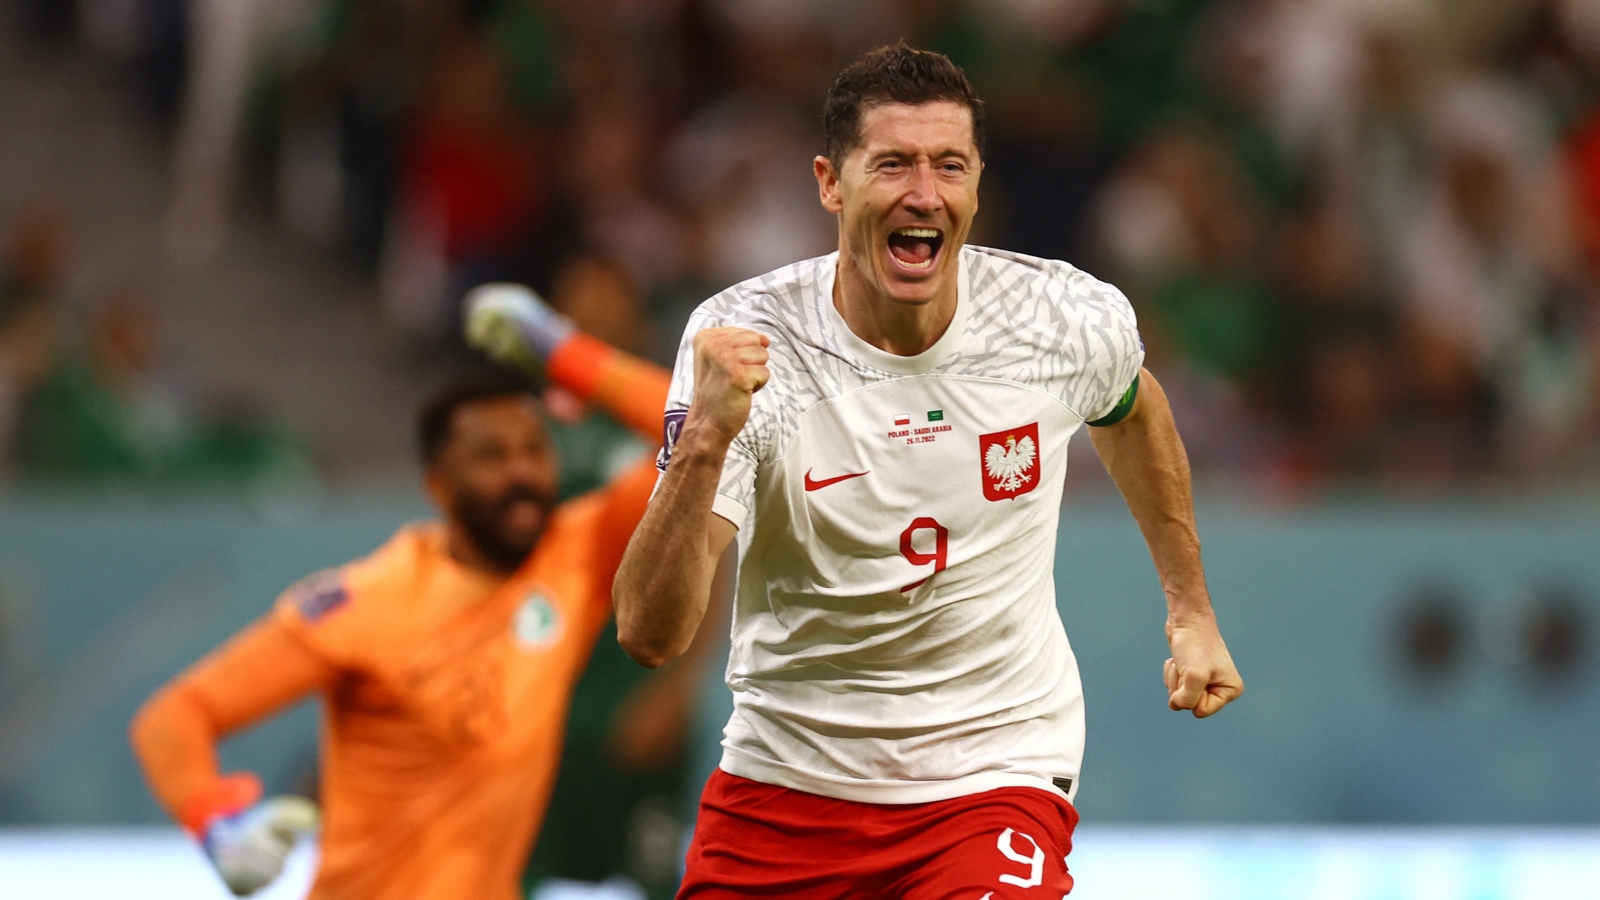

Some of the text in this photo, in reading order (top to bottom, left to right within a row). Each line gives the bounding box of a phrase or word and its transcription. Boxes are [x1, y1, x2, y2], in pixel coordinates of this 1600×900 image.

[888, 430, 909, 438] POLAND
[914, 427, 931, 435] SAUDI
[932, 425, 952, 433] ARABIA
[906, 436, 935, 444] 26.11.2022
[900, 517, 948, 593] 9
[997, 827, 1045, 888] 9
